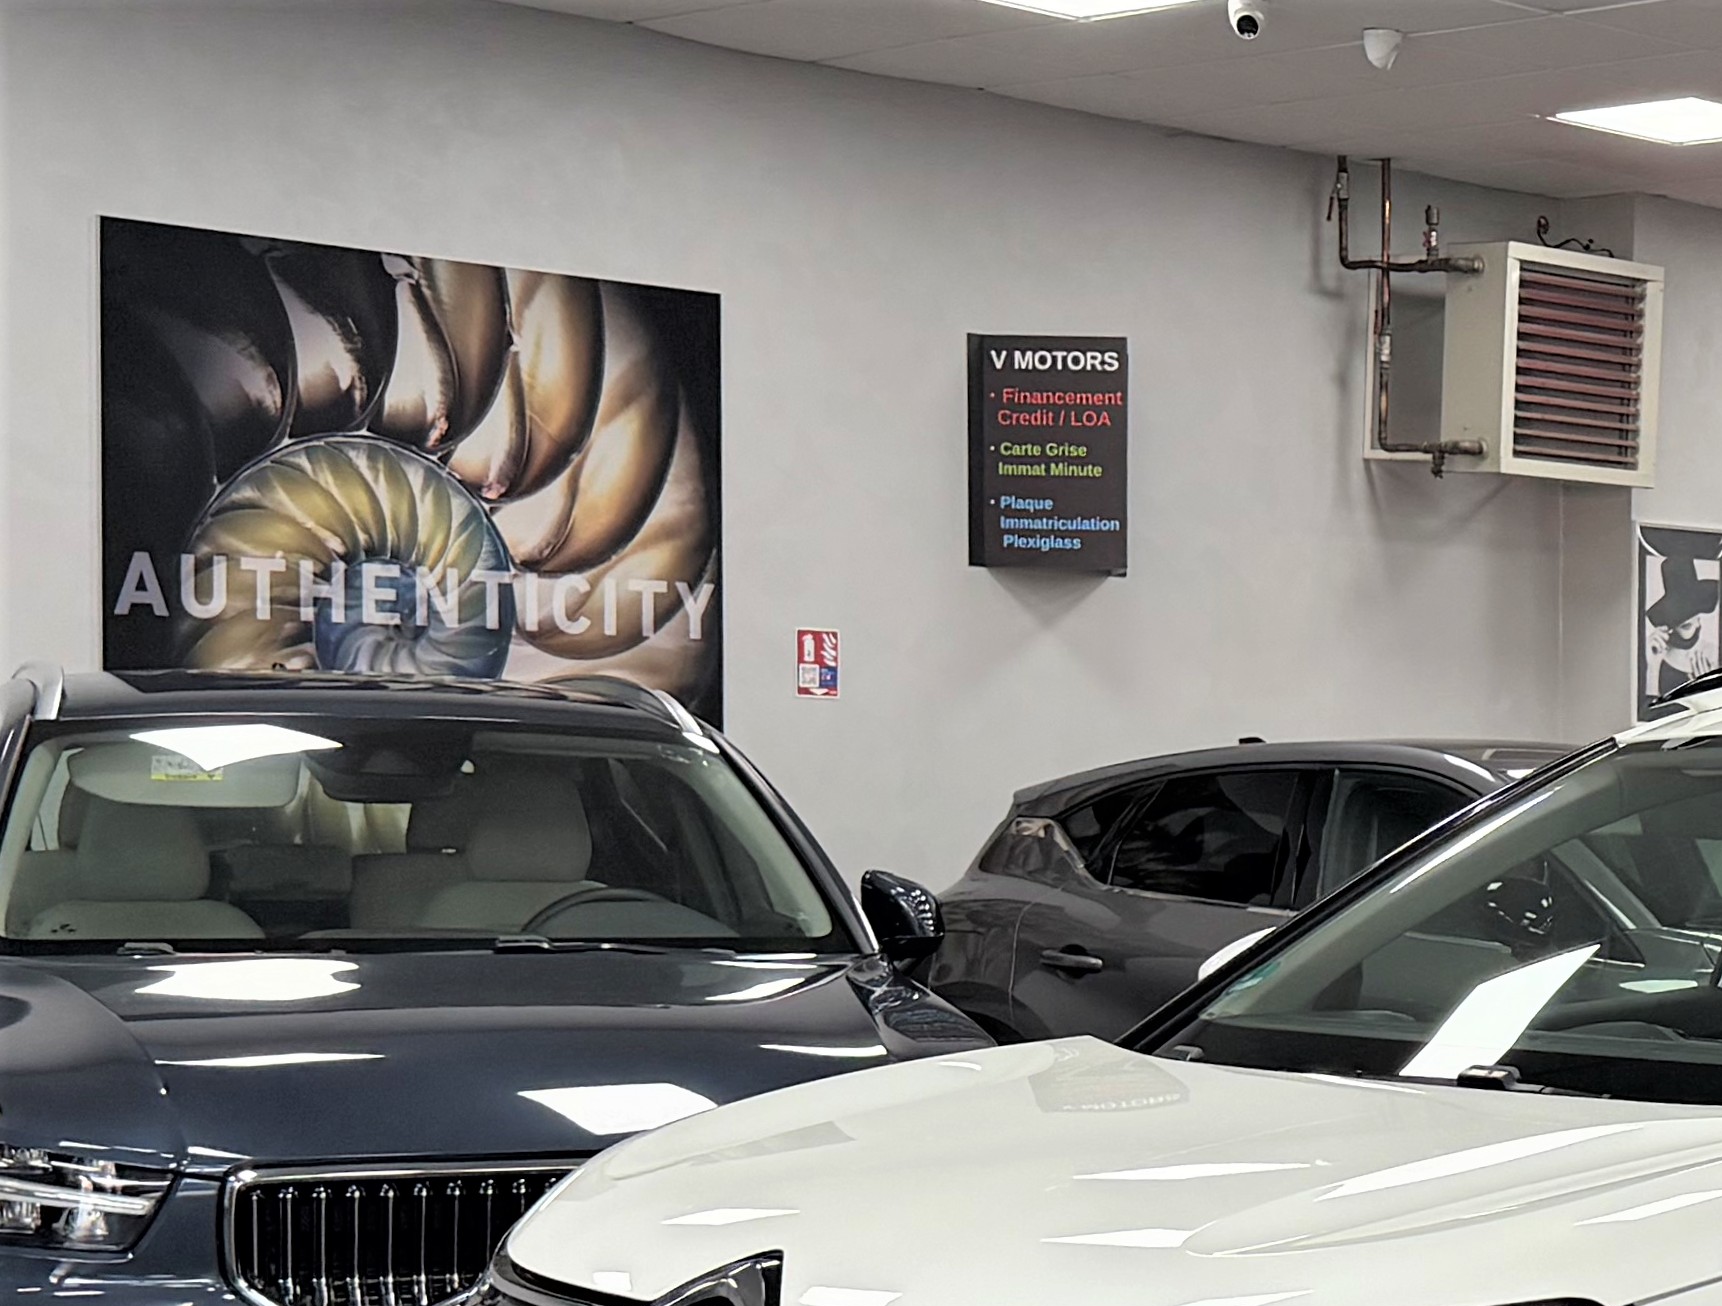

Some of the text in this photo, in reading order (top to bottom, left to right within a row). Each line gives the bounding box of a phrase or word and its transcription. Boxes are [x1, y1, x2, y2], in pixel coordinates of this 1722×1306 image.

[990, 350, 1120, 371] V MOTORS
[1002, 387, 1123, 406] Financement
[998, 410, 1054, 427] Credit
[1070, 410, 1112, 427] LOA
[1000, 442, 1088, 457] Carte Grise
[998, 462, 1103, 478] Immat Minute
[1000, 496, 1054, 513] Plaque
[1000, 516, 1120, 532] Immatriculation
[1002, 535, 1082, 552] Plexiglass
[113, 551, 715, 640] AUTHENTICITY
